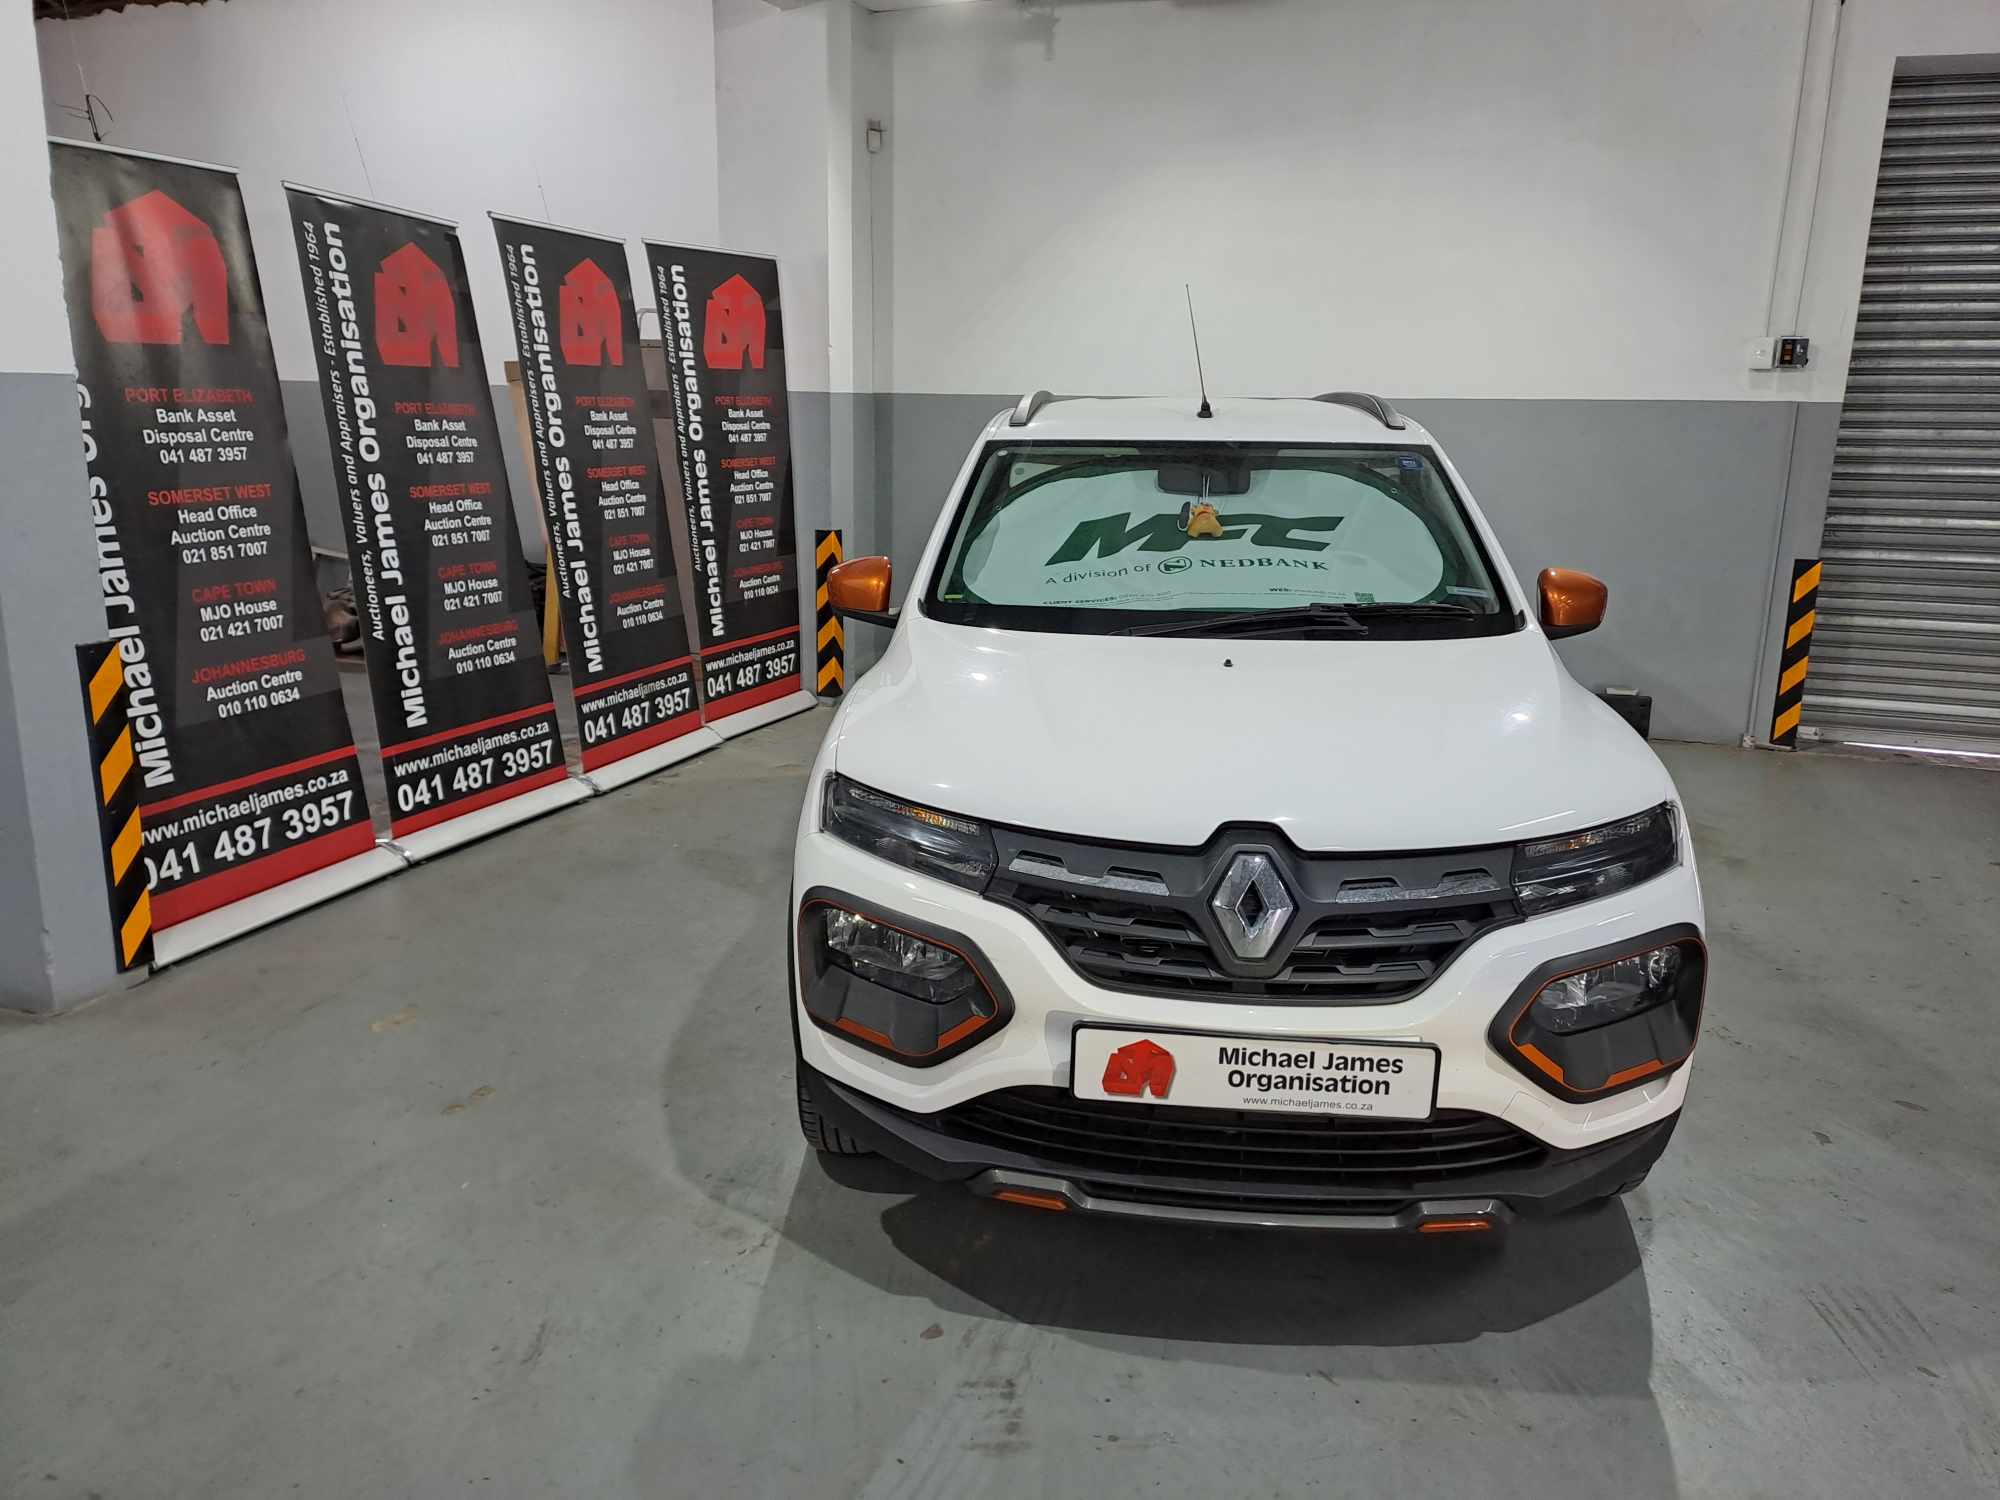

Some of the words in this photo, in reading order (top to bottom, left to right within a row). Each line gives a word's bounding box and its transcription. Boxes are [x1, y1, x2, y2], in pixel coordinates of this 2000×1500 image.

[303, 221, 321, 262] 1964
[310, 266, 336, 356] Established
[124, 387, 168, 402] PORT
[156, 408, 193, 424] Bank
[197, 409, 237, 423] Asset
[331, 370, 353, 452] Appraisers
[142, 428, 207, 447] Disposal
[210, 428, 254, 442] Centre
[415, 419, 440, 431] Bank
[442, 420, 466, 431] Asset
[160, 450, 185, 464] 041
[189, 448, 213, 462] 487
[218, 447, 247, 461] 3957
[406, 436, 450, 450] Disposal
[451, 436, 478, 447] Centre
[537, 441, 549, 467] and
[342, 454, 358, 485] and
[417, 453, 434, 464] 041
[437, 452, 453, 463] 487
[147, 486, 232, 506] SOMERSET
[235, 484, 272, 499] WEST
[694, 449, 714, 533] James
[177, 508, 214, 524] Head
[217, 505, 258, 520] Office
[352, 489, 369, 544] Valuers
[429, 501, 454, 513] Head
[456, 500, 483, 512] Office
[556, 457, 584, 553] James
[170, 529, 225, 546] Auction
[228, 523, 272, 539] Centre
[368, 473, 403, 586] James
[425, 519, 462, 531] Auction
[464, 516, 492, 527] Centre
[90, 476, 135, 614] James
[182, 549, 206, 564] 021
[210, 546, 234, 561] 851
[238, 541, 268, 557] 7007
[432, 535, 449, 547] 021
[452, 533, 469, 545] 851
[1063, 568, 1128, 584] division
[1134, 564, 1152, 572] of
[1201, 558, 1329, 571] NEDBANK
[192, 585, 231, 602] CAPE
[235, 579, 278, 595] TOWN
[444, 581, 466, 595] MJO
[468, 578, 498, 591] House
[702, 539, 725, 637] Michael
[200, 604, 231, 623] MJO
[235, 600, 277, 616] House
[444, 599, 460, 611] 021
[463, 596, 480, 608] 421
[482, 591, 502, 604] 7007
[201, 627, 224, 642] 021
[228, 622, 251, 637] 421
[254, 615, 284, 633] 7007
[570, 561, 604, 674] Michael
[385, 595, 428, 728] Michael
[448, 643, 485, 660] Auction
[487, 638, 517, 651] Centre
[706, 639, 795, 672] www.michaeljames.co.za
[192, 649, 305, 684] JOHANNESBURG
[457, 661, 473, 674] 010
[475, 657, 492, 670] 110
[707, 673, 732, 698] 041
[737, 665, 761, 689] 487
[766, 654, 796, 679] 3957
[207, 681, 258, 701] Auction
[261, 670, 303, 688] Centre
[581, 672, 688, 714] www.michaeljames.co.za
[109, 625, 175, 788] Michael
[219, 703, 242, 719] 010
[245, 697, 268, 713] 110
[270, 688, 301, 707] 0634
[584, 715, 616, 744] 041
[622, 702, 650, 730] 487
[655, 688, 690, 719] 3957
[394, 721, 549, 777] www.michaeljames.co.za
[398, 774, 444, 813] 041
[453, 758, 494, 792] 487
[502, 740, 553, 778] 3957
[141, 769, 349, 847] ww.michaeljames.co.za
[214, 817, 272, 862] 487
[282, 791, 354, 840] 3957
[1219, 1047, 1315, 1068] Michael
[1323, 1052, 1404, 1074] James
[1228, 1069, 1390, 1095] Organisation
[1243, 1096, 1373, 1111] www.michaeljames.co.za
